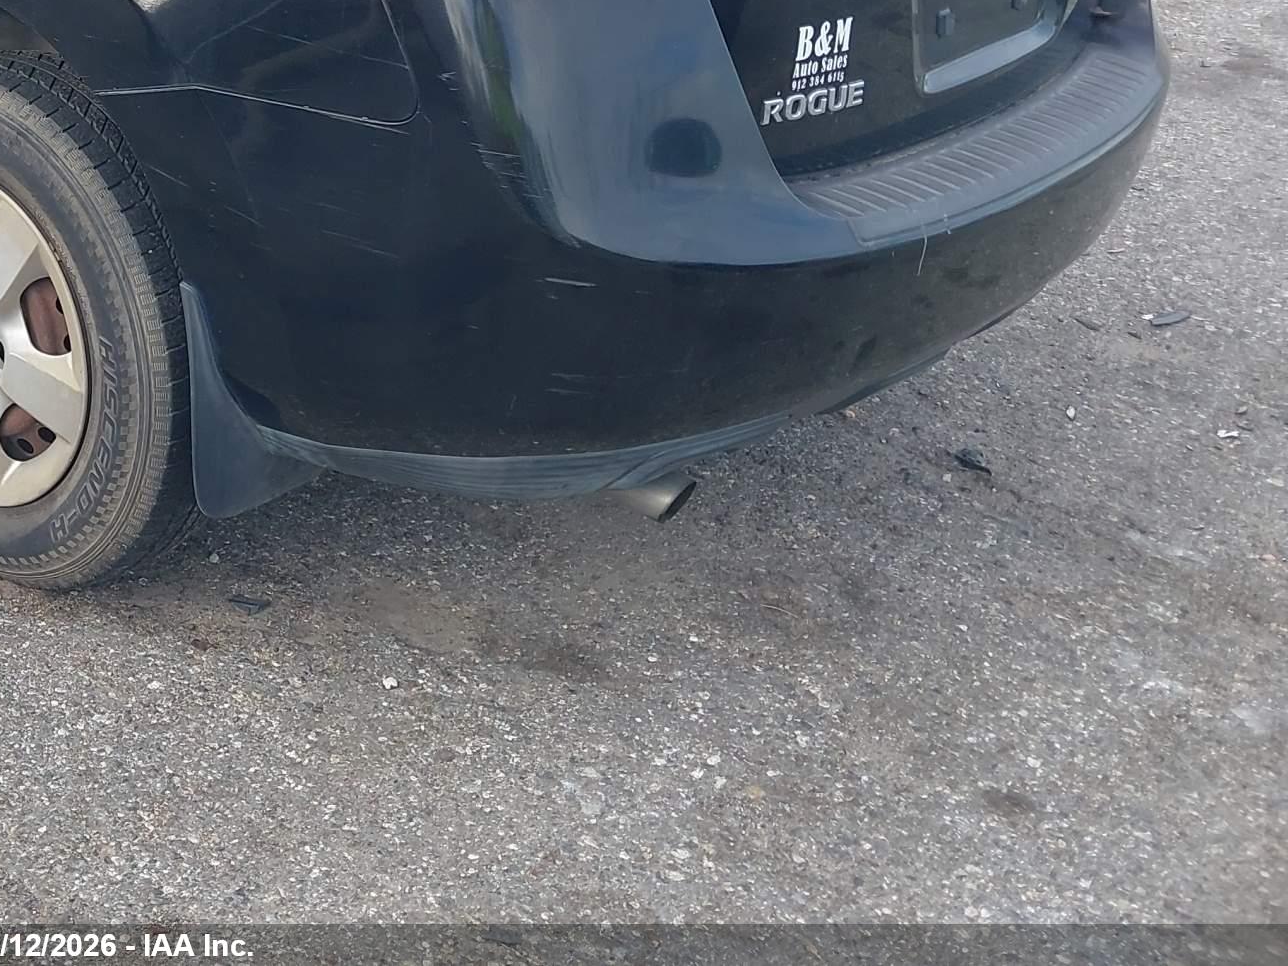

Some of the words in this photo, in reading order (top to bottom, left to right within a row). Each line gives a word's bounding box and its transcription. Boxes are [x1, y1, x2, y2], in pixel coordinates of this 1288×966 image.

[795, 16, 853, 61] B&M
[791, 78, 807, 92] 912
[809, 73, 825, 87] 384
[827, 71, 844, 83] 6115
[792, 60, 819, 78] Auto
[821, 54, 848, 73] Sales
[760, 79, 864, 126] ROGUE
[49, 336, 119, 543] HISCEND-H
